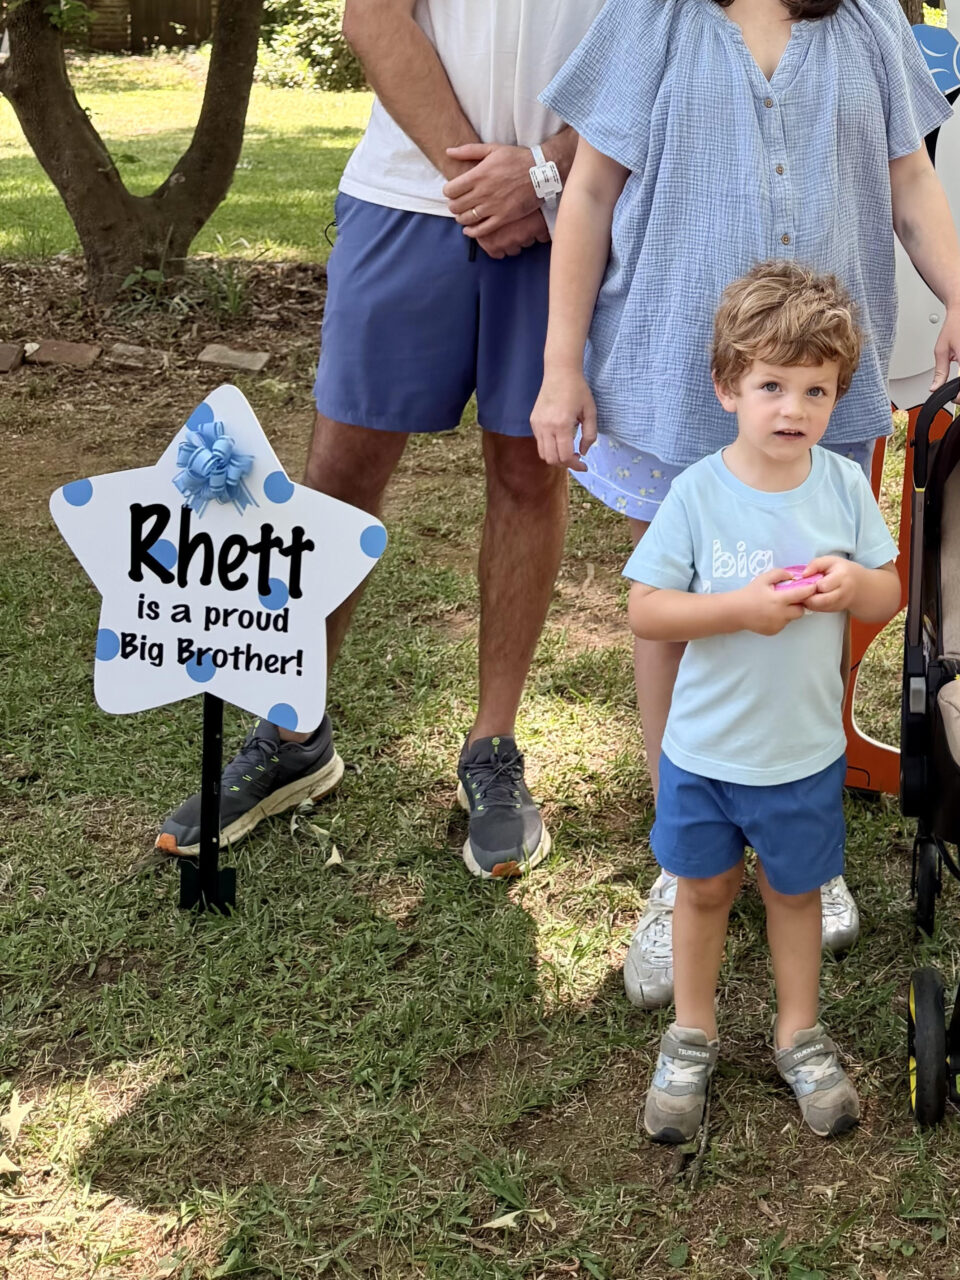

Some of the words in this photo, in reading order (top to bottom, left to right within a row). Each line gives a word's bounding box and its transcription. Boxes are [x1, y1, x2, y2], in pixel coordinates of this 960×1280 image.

[127, 502, 315, 600] Rhett
[137, 593, 160, 621] is
[170, 603, 192, 624] a
[204, 606, 290, 634] proud
[120, 631, 164, 668] Big
[177, 637, 304, 677] Brother!
